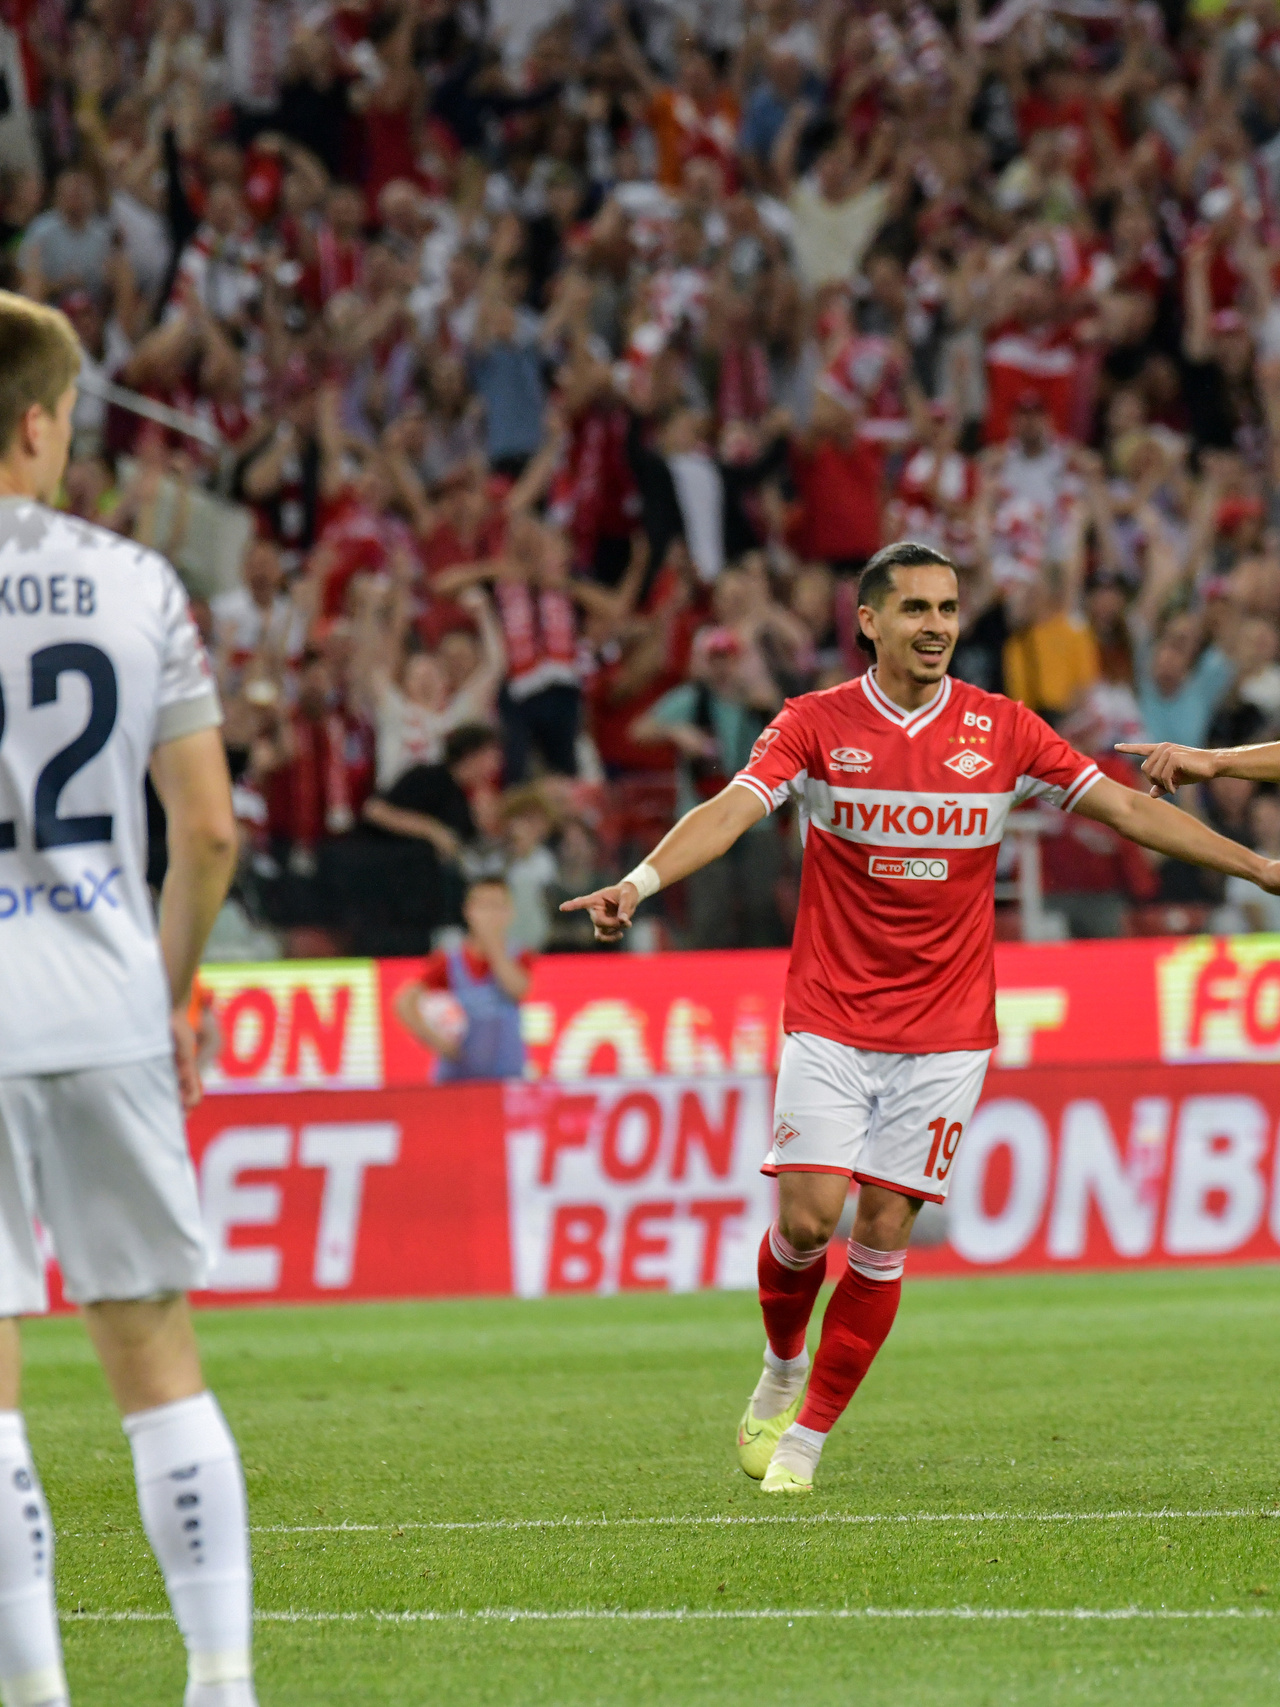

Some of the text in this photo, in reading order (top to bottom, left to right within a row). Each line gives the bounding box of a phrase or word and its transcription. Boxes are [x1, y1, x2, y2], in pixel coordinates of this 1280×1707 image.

[963, 711, 993, 732] BQ
[829, 762, 872, 774] CHERY
[831, 800, 988, 836] ЛУКОЙЛ
[200, 986, 351, 1078] ON
[538, 1089, 742, 1186] FON
[923, 1116, 963, 1181] 19
[546, 1198, 747, 1295] BET
